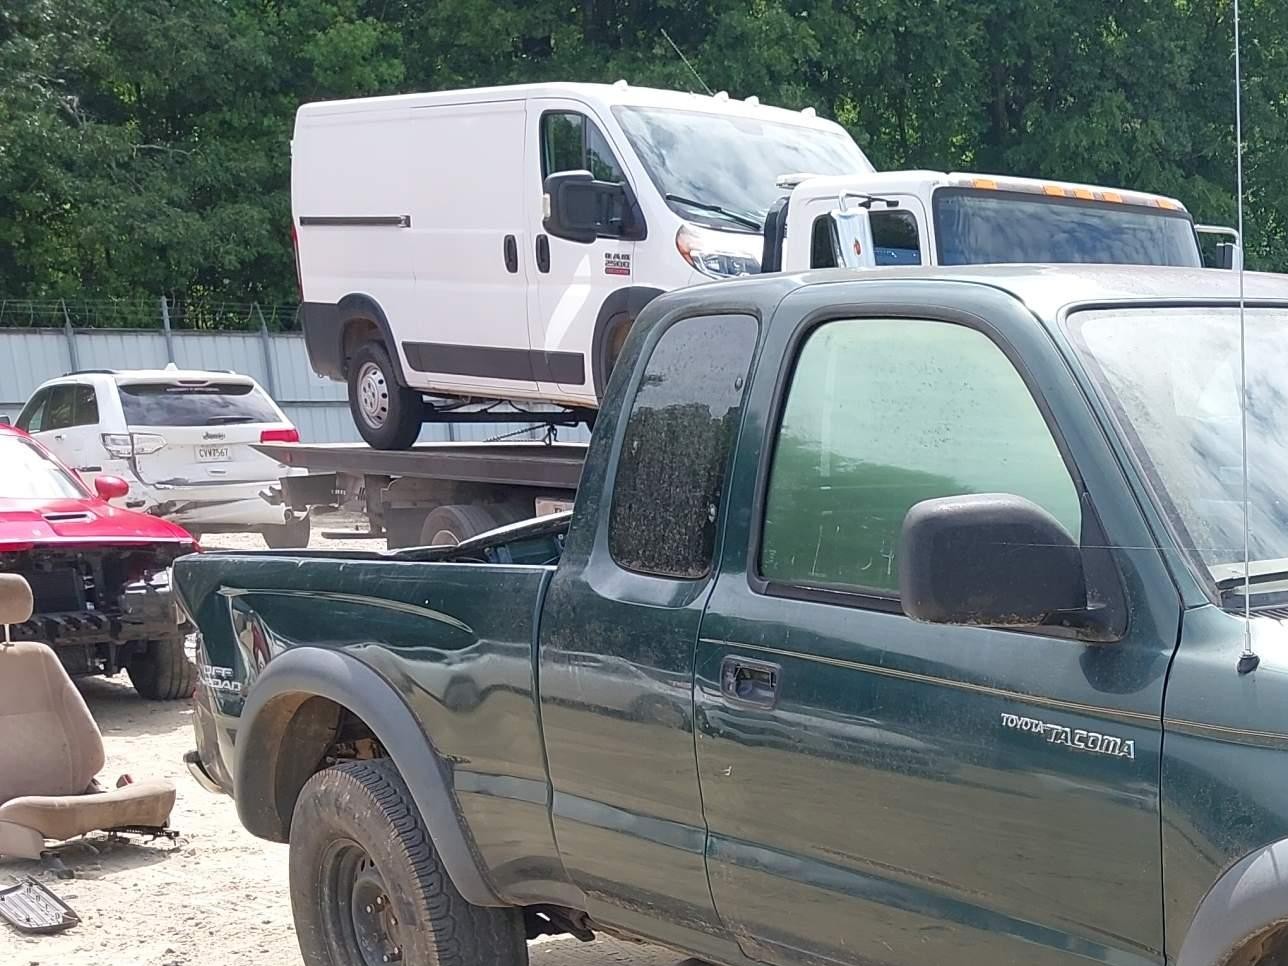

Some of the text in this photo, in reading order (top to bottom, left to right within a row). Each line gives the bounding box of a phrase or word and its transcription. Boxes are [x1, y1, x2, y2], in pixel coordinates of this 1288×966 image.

[204, 665, 232, 677] OFF
[1000, 712, 1136, 760] TOYOTA TACOMA
